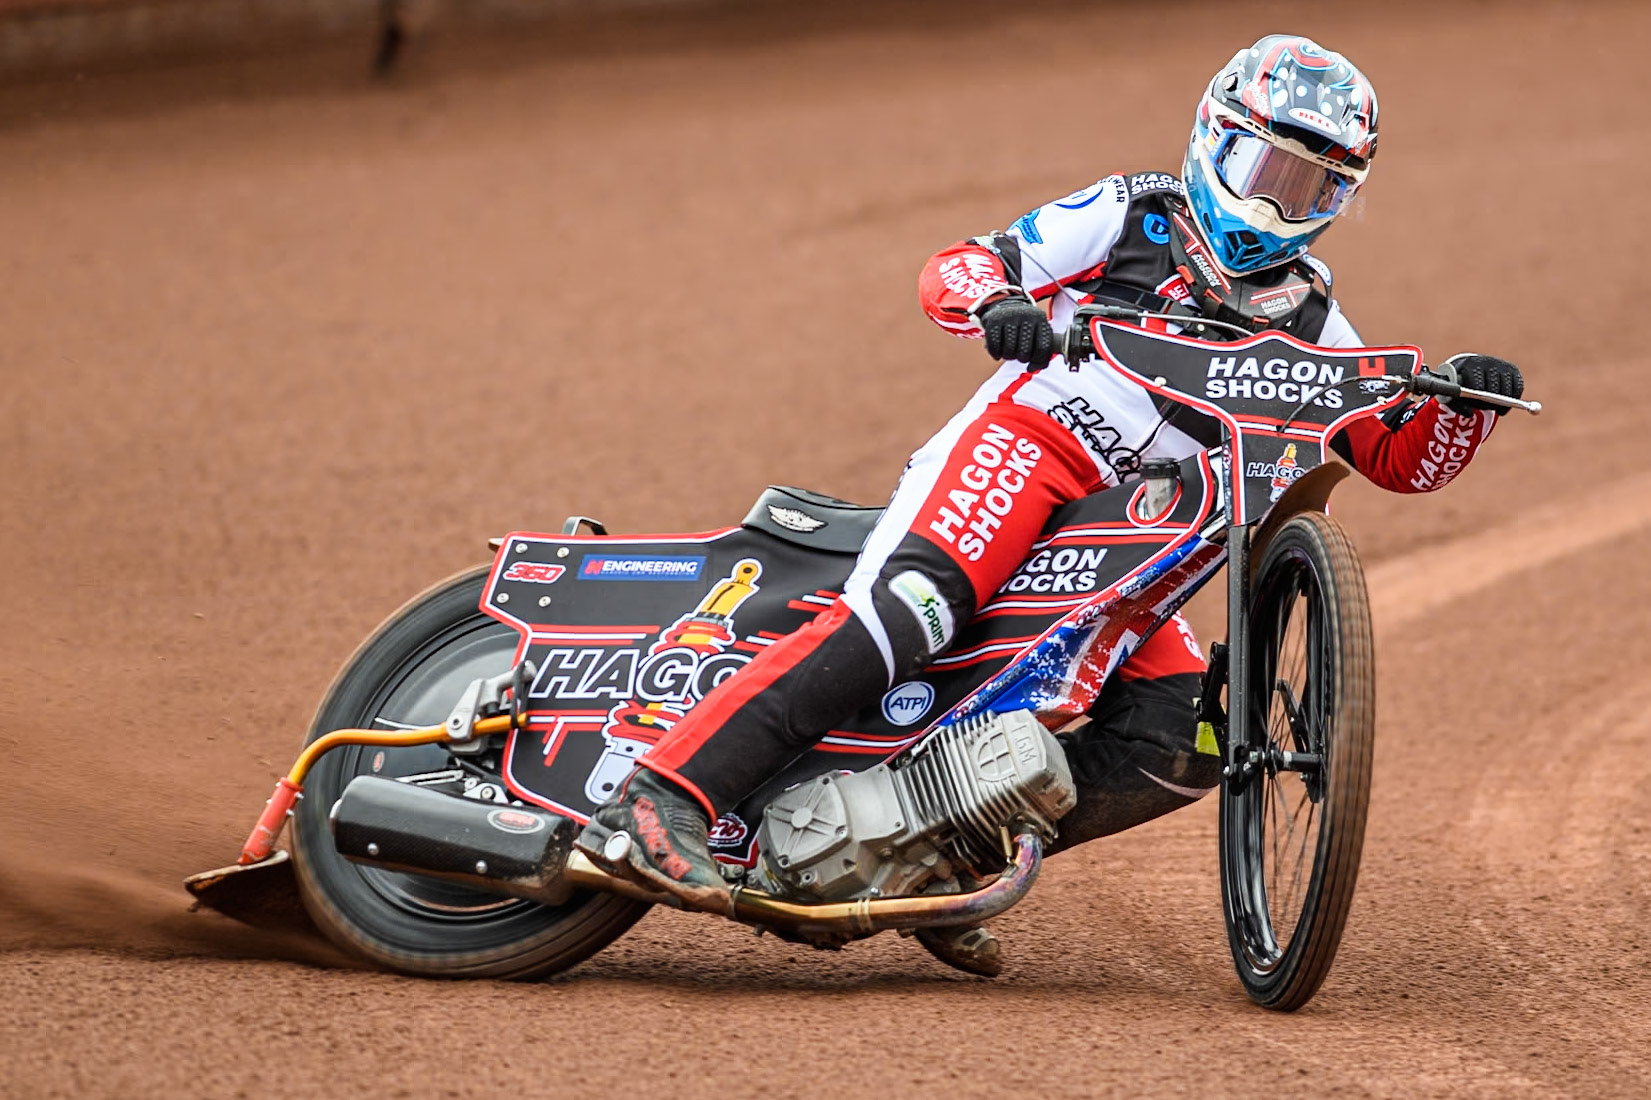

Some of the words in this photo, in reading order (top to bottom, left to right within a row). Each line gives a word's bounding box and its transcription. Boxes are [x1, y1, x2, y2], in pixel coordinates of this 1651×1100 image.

[1207, 356, 1344, 385] HAGON
[1206, 378, 1344, 409] SHOCKS
[1410, 403, 1457, 491] HAGON
[928, 422, 1016, 545] HAGON
[957, 437, 1043, 562] SHOCKS
[602, 560, 698, 573] ENGINEERING
[890, 696, 926, 710] ATPI
